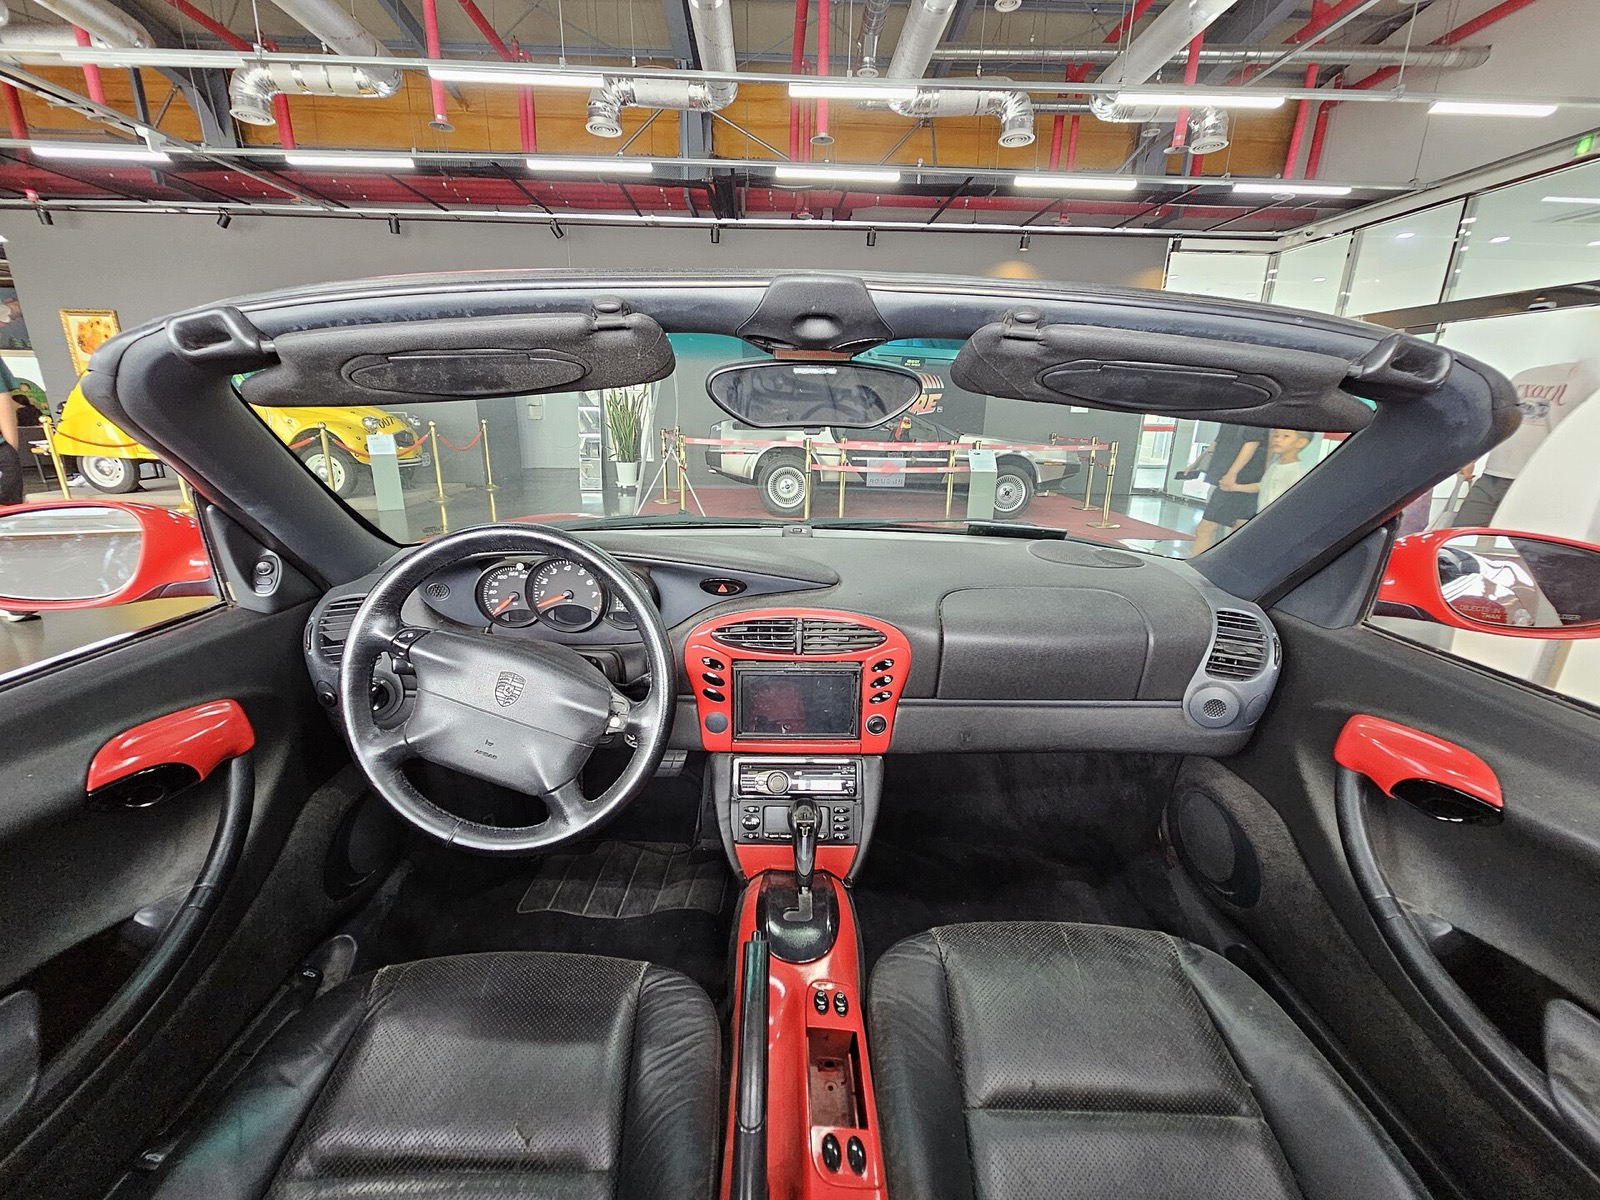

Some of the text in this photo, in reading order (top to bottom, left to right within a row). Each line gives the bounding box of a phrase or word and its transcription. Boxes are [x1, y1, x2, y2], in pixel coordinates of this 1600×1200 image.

[378, 416, 394, 428] 007
[577, 568, 586, 576] 5
[540, 577, 549, 585] 2
[591, 591, 598, 599] 7
